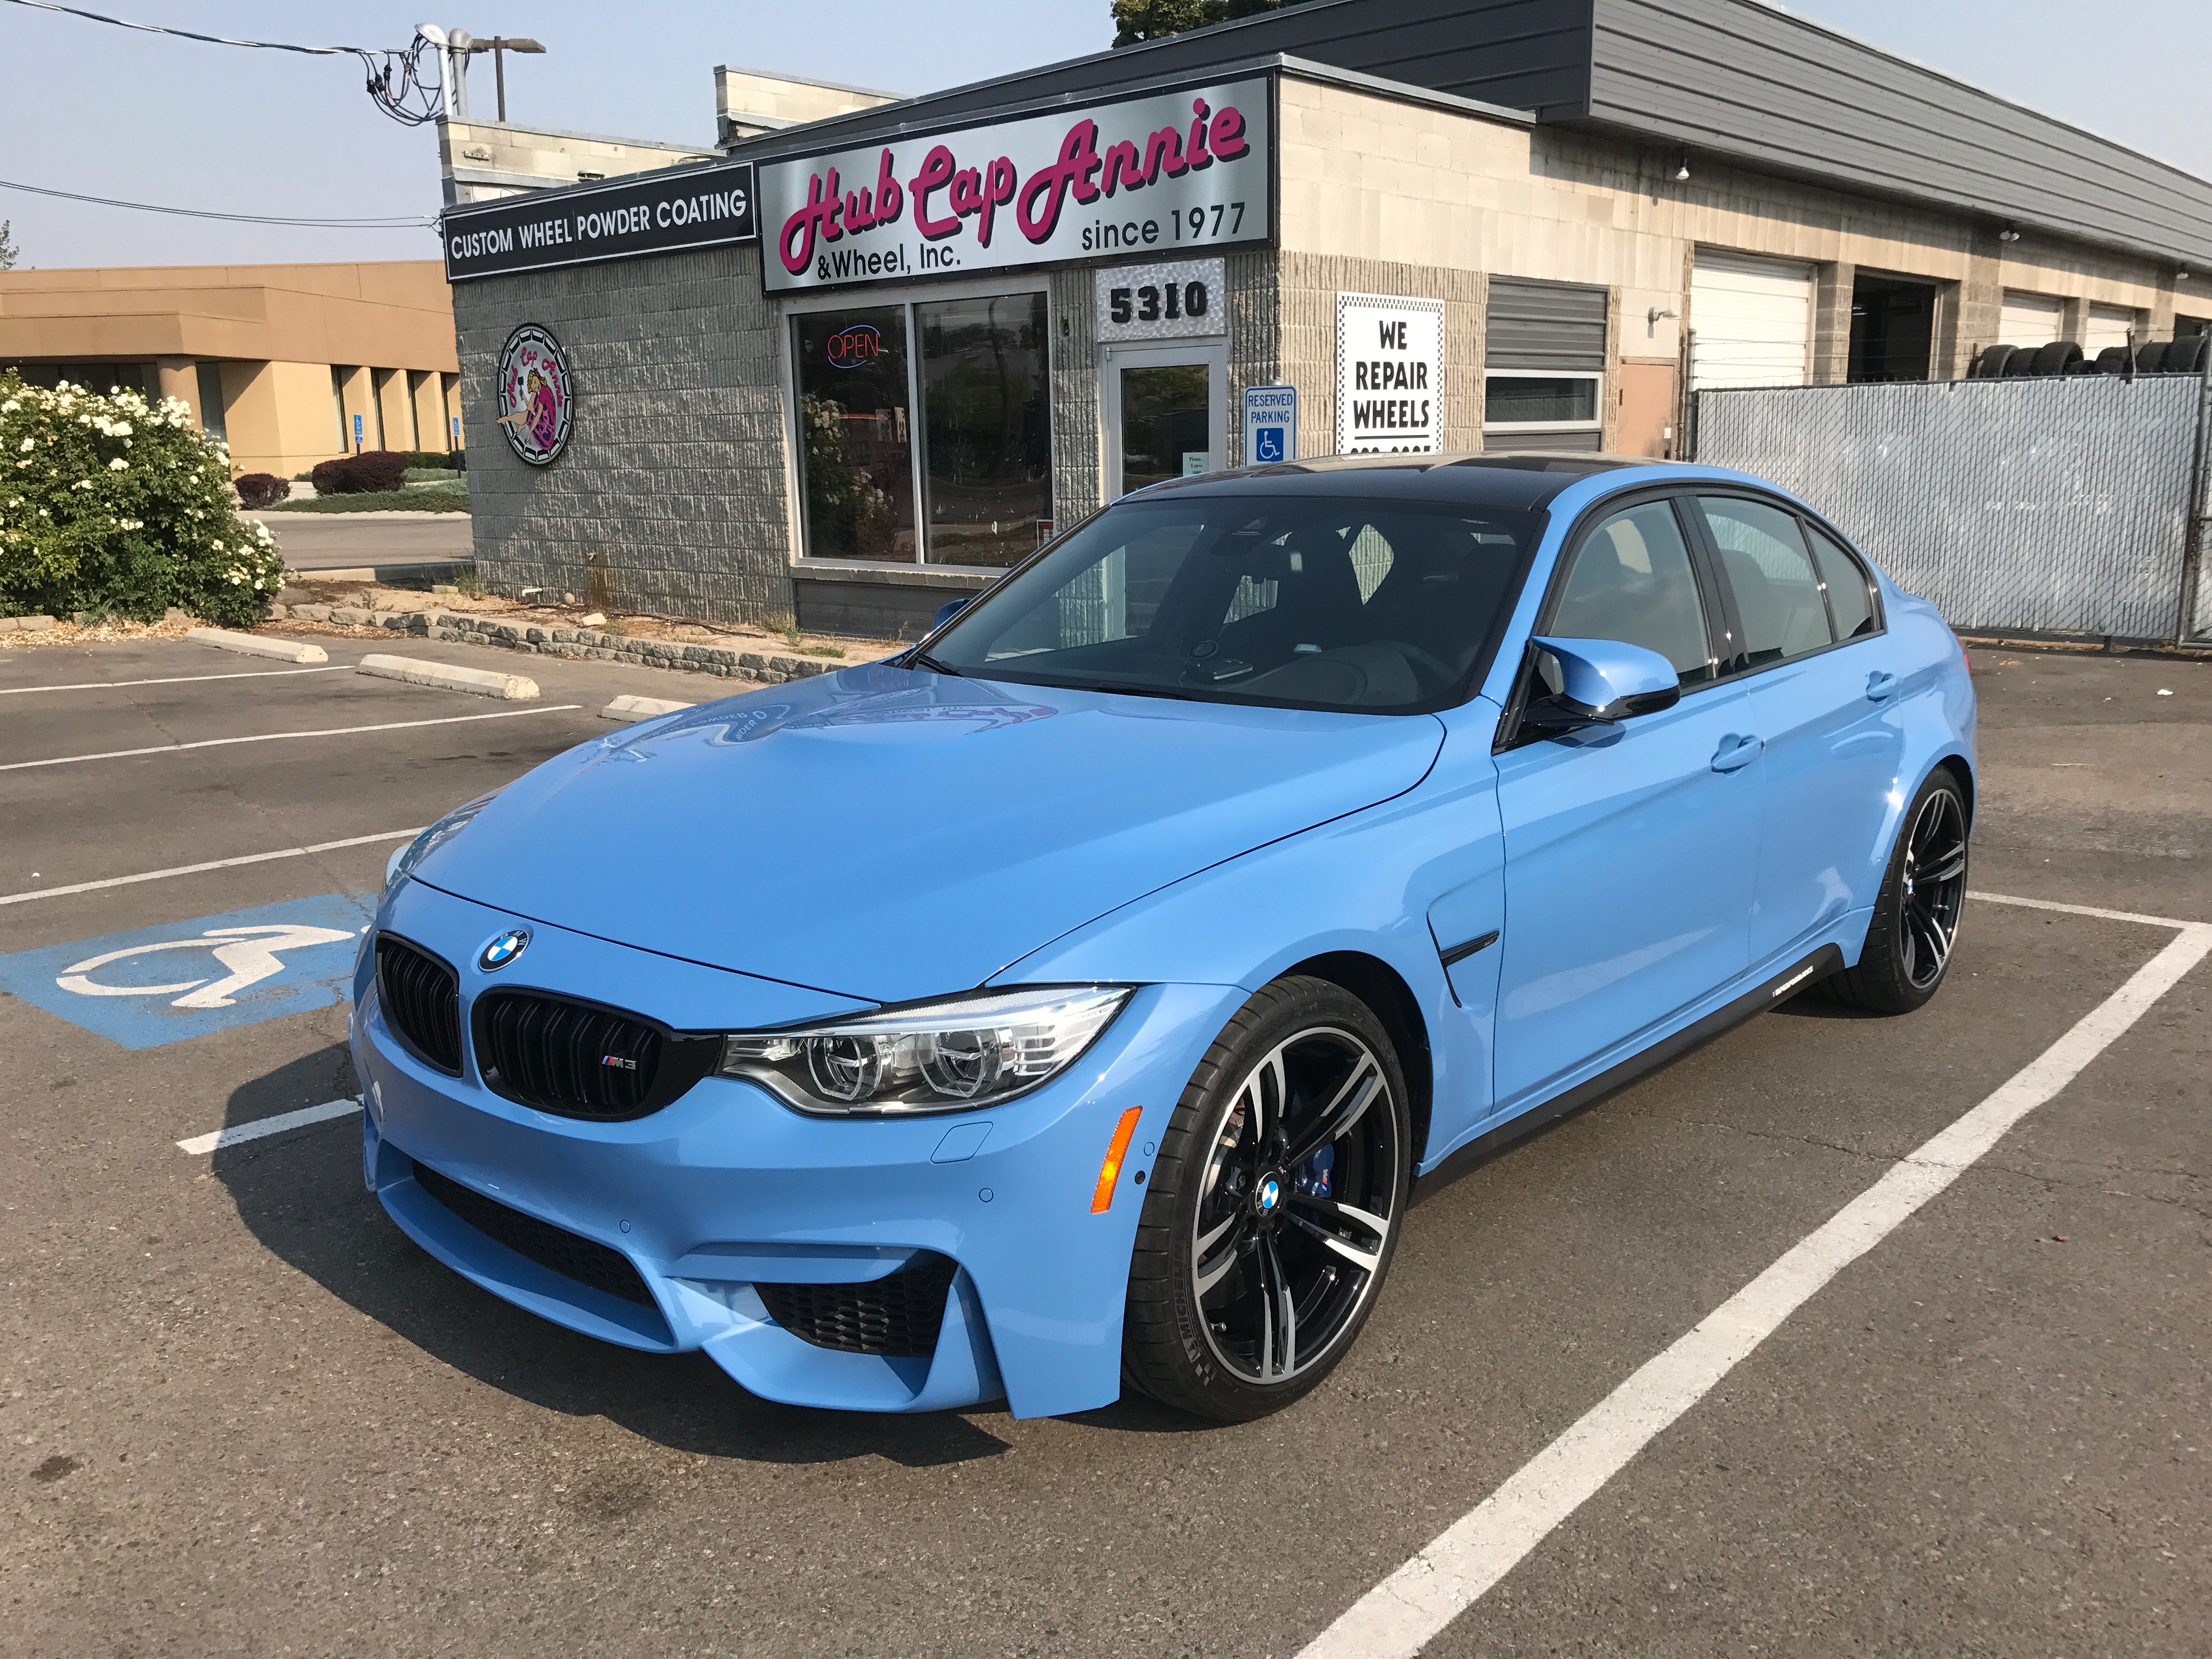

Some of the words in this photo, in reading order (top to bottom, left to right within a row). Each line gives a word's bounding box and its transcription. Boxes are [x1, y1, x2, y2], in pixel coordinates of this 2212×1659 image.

[779, 148, 902, 273] Hub
[908, 145, 1015, 246] Cap
[1017, 98, 1249, 243] Annie
[451, 228, 512, 259] CUSTOM
[519, 219, 572, 249] WHEEL
[578, 205, 650, 240] POWDER
[657, 189, 746, 228] COATING
[1082, 219, 1159, 251] since
[1171, 201, 1246, 241] 1977
[920, 244, 961, 269] Inc.
[1110, 281, 1207, 324] 5310
[827, 333, 878, 359] OPEN
[1379, 320, 1408, 350] WE
[520, 346, 538, 368] Cap
[1356, 361, 1428, 390] REPAIR
[1248, 394, 1293, 407] RESERVED
[1353, 399, 1430, 429] WHEELS
[1251, 410, 1290, 424] PARKING
[1256, 1183, 1268, 1216] BMW
[1173, 1243, 1193, 1340] MICHELIN
